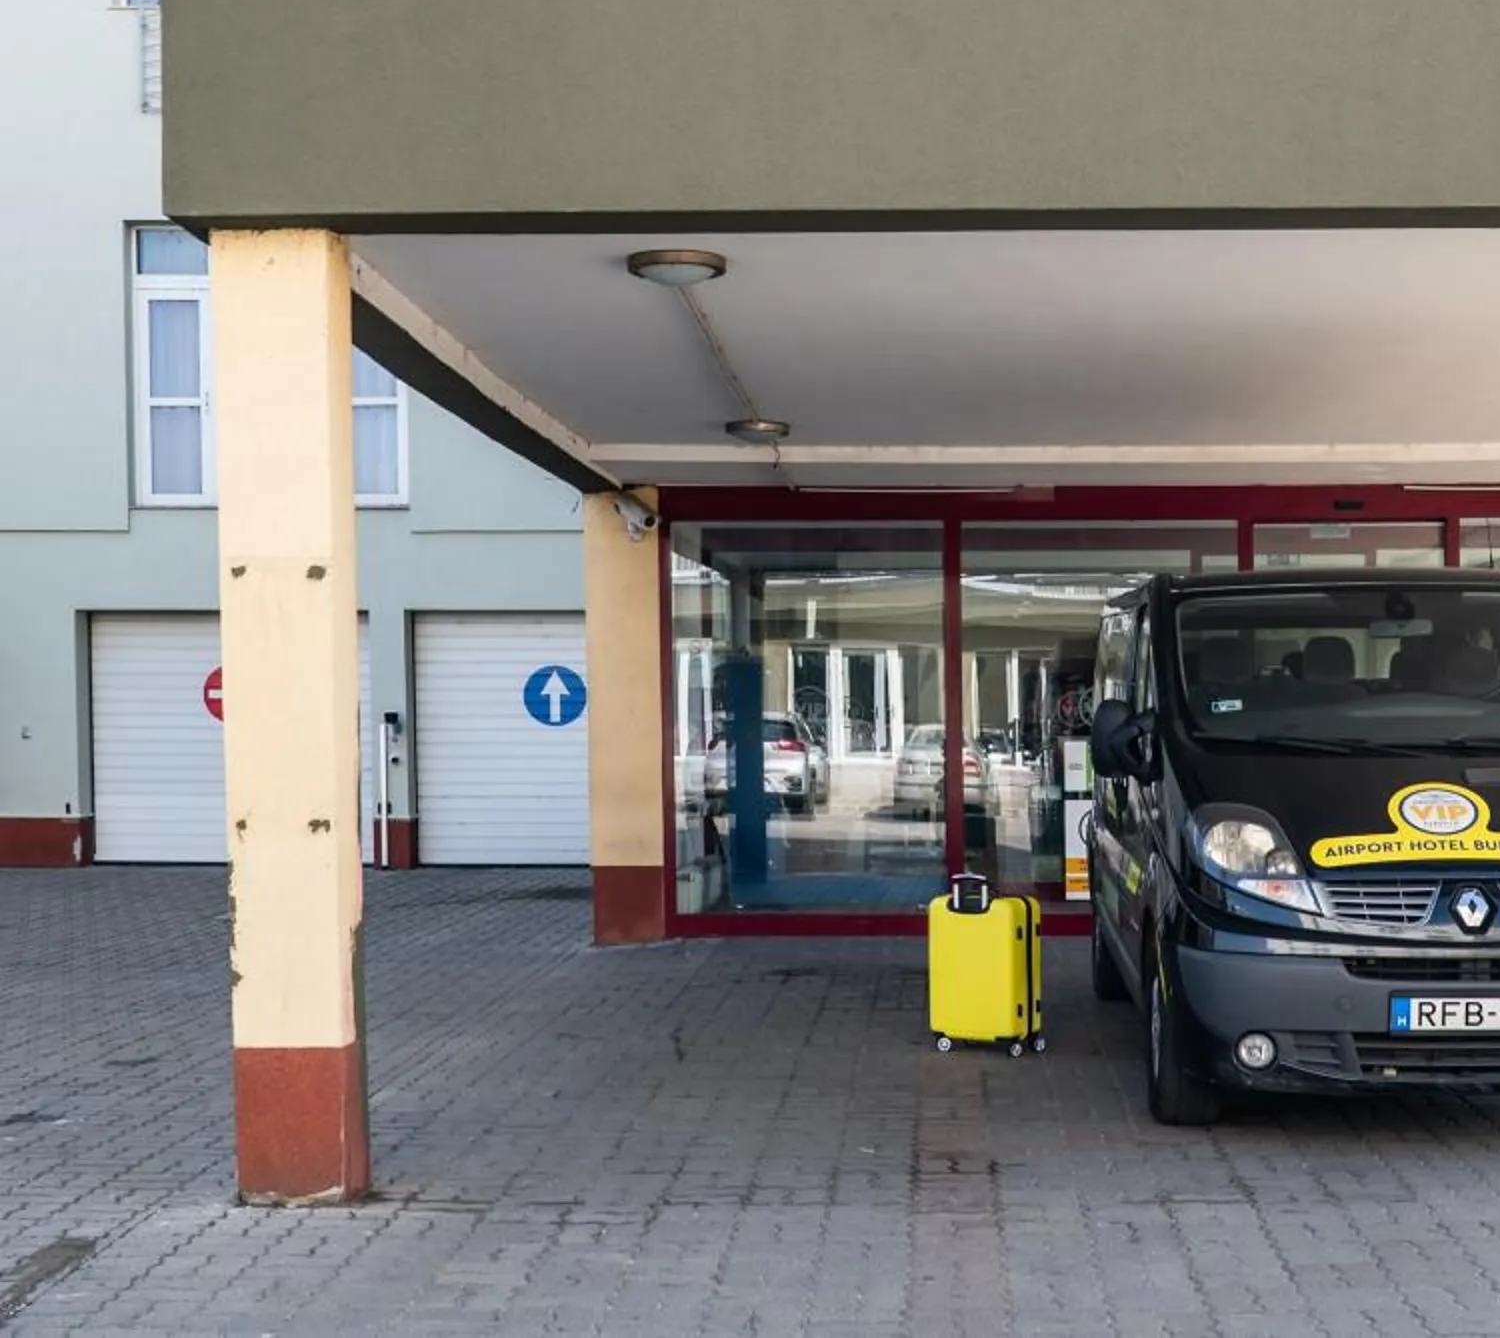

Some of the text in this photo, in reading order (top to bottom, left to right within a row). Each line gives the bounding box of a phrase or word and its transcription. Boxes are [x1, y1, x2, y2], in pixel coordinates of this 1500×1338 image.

[1409, 805, 1470, 822] VIP
[1325, 841, 1404, 858] AIRPORT
[1409, 839, 1467, 852] HOTEL
